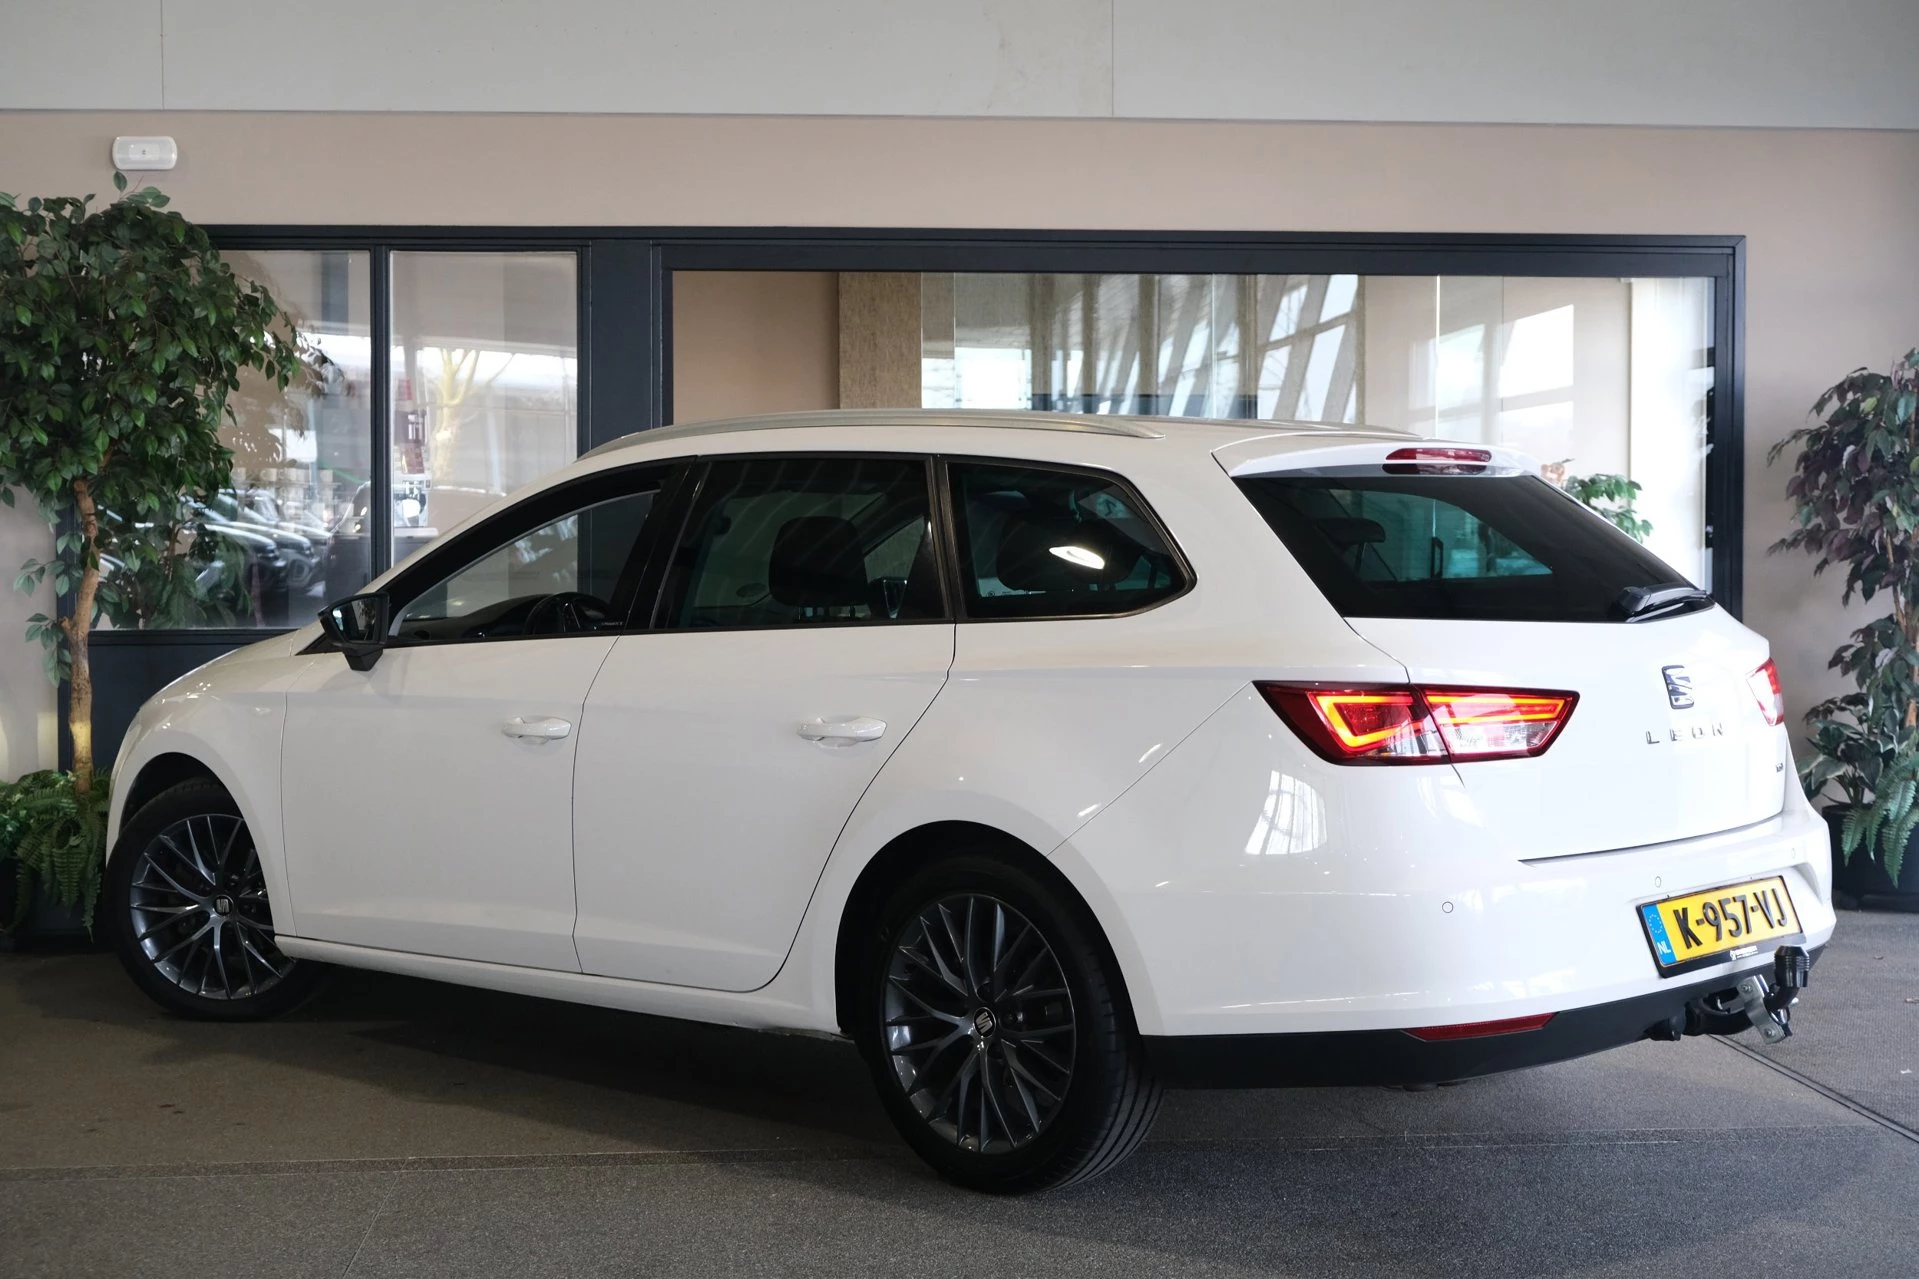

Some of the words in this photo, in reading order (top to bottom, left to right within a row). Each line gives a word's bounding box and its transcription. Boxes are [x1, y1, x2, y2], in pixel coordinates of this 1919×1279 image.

[1645, 722, 1724, 745] LEON
[1672, 887, 1788, 950] K-957-VJ
[1656, 941, 1672, 955] NL
